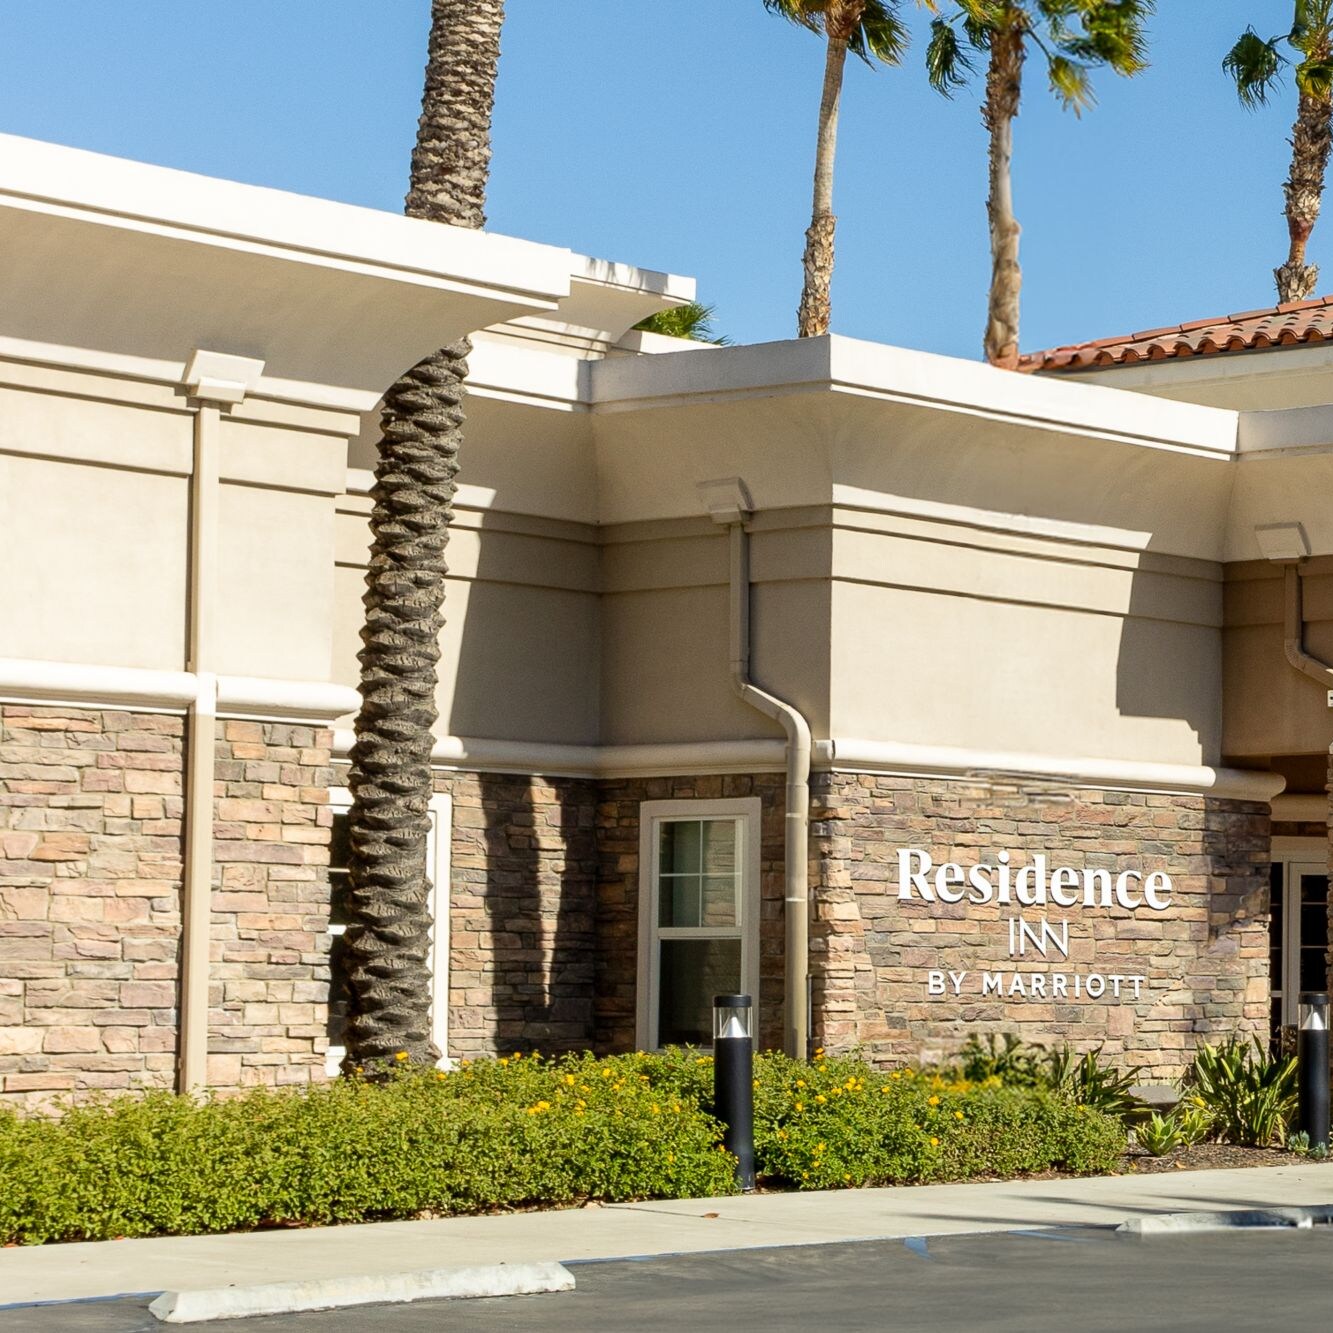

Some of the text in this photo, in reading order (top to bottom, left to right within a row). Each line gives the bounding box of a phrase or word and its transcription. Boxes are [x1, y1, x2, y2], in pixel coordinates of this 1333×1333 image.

[896, 848, 1173, 910] Residence
[1009, 916, 1069, 958] INN
[928, 970, 1145, 1000] BY MARRIOTT
